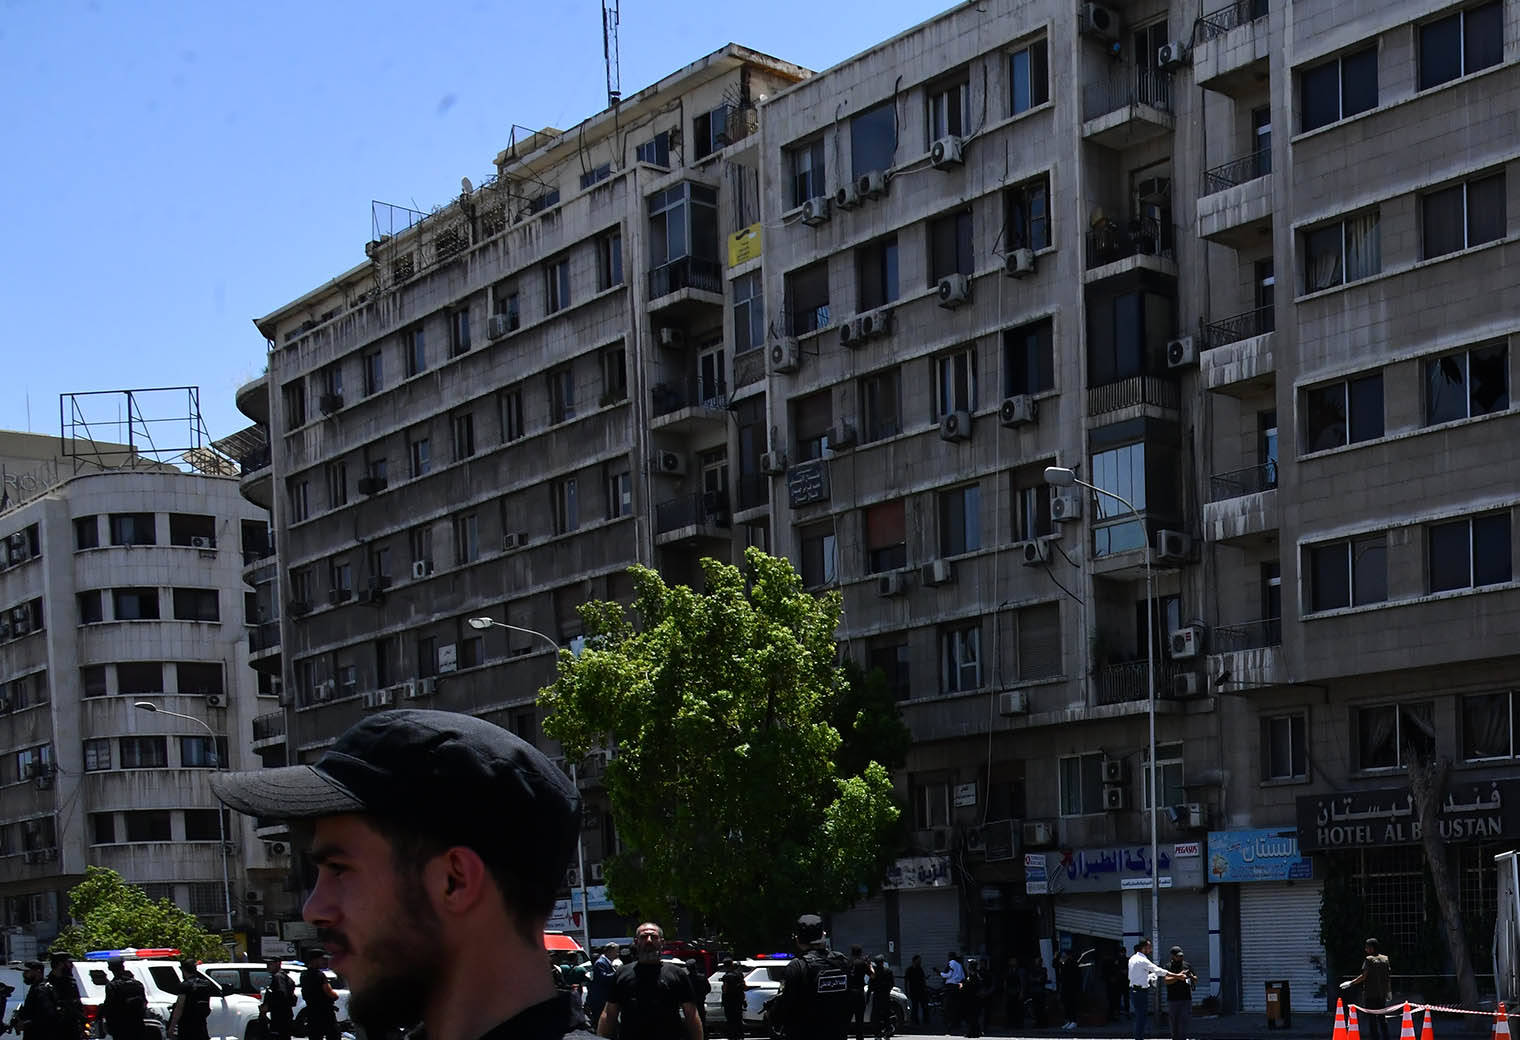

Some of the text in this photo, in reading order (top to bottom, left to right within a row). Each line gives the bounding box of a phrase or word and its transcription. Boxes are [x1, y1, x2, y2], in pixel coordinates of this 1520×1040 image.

[1317, 792, 1414, 826] لبستان
[1316, 816, 1503, 846] HOTEL AL BUSTAN
[1067, 848, 1123, 880] الطيران
[1242, 837, 1298, 865] البستان
